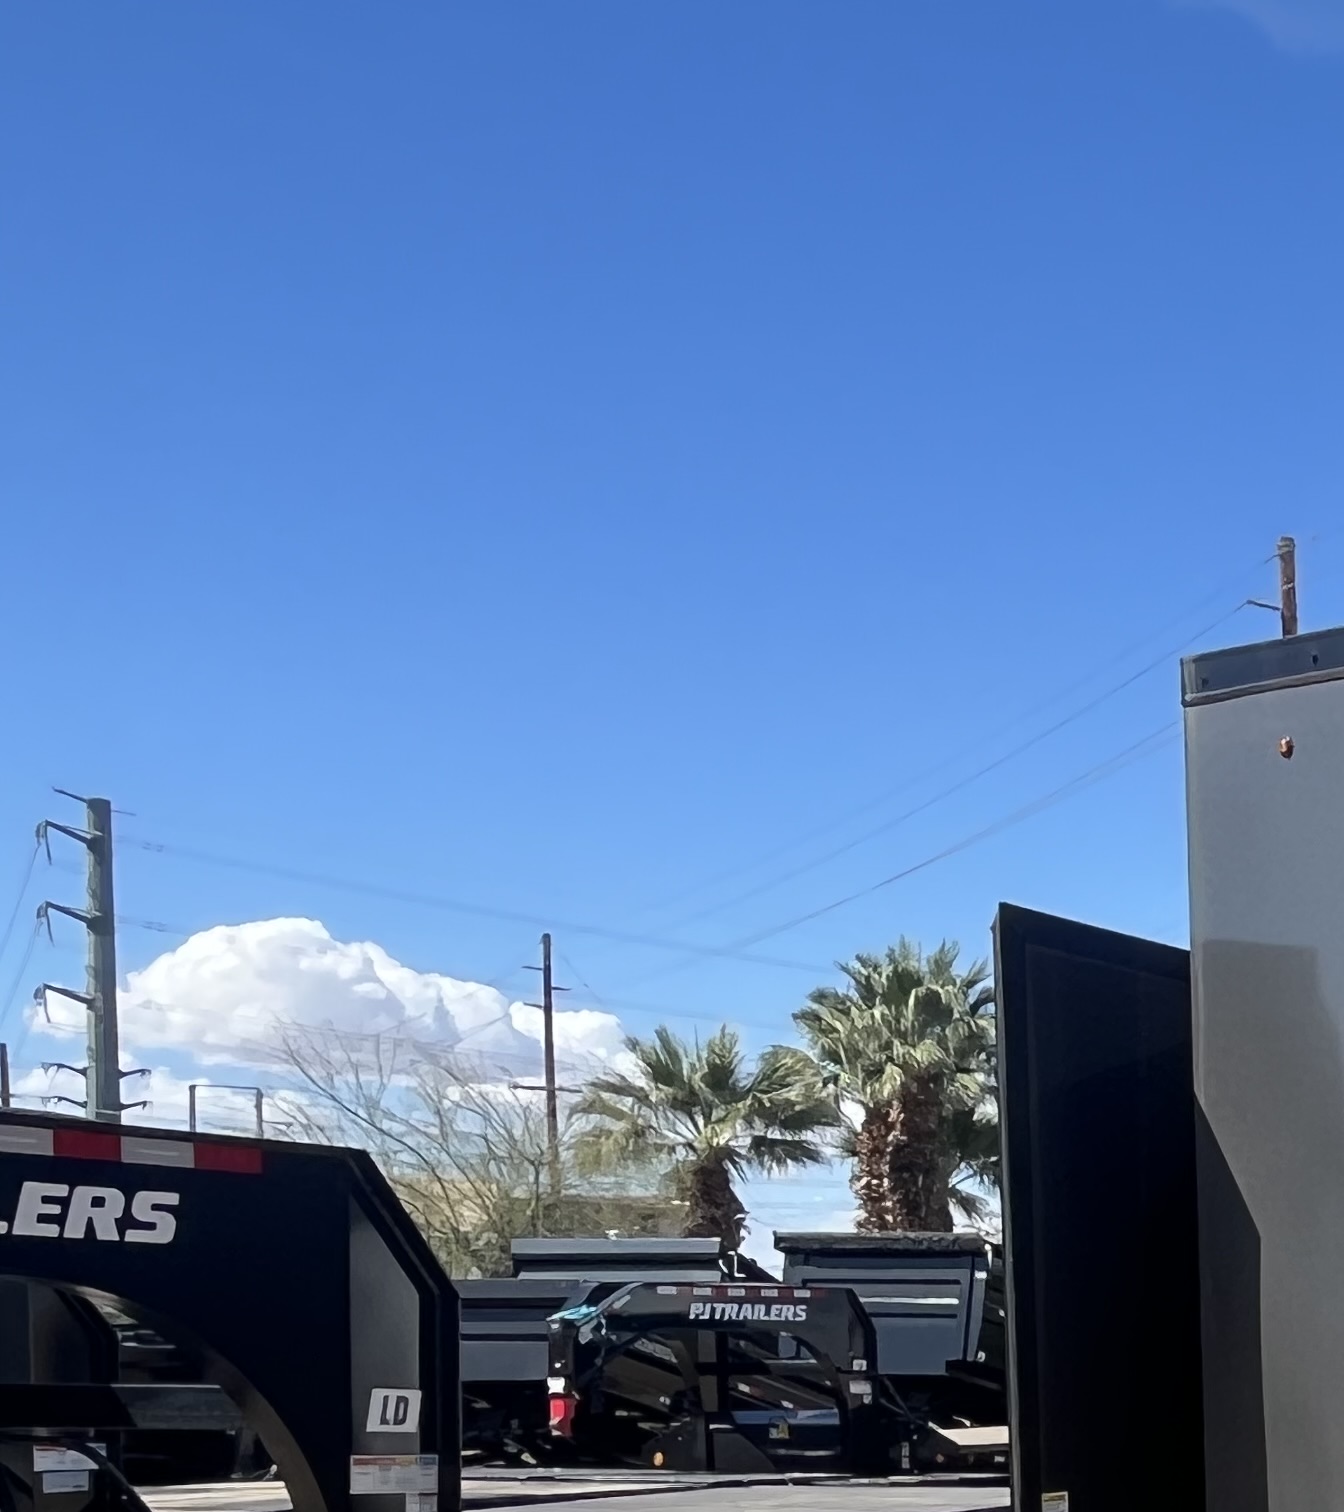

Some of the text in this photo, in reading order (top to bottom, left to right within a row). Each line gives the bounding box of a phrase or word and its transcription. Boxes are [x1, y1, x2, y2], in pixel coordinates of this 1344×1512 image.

[0, 1181, 180, 1244] ERS
[689, 1302, 808, 1321] PJ TRAILERS
[379, 1395, 409, 1426] LD
